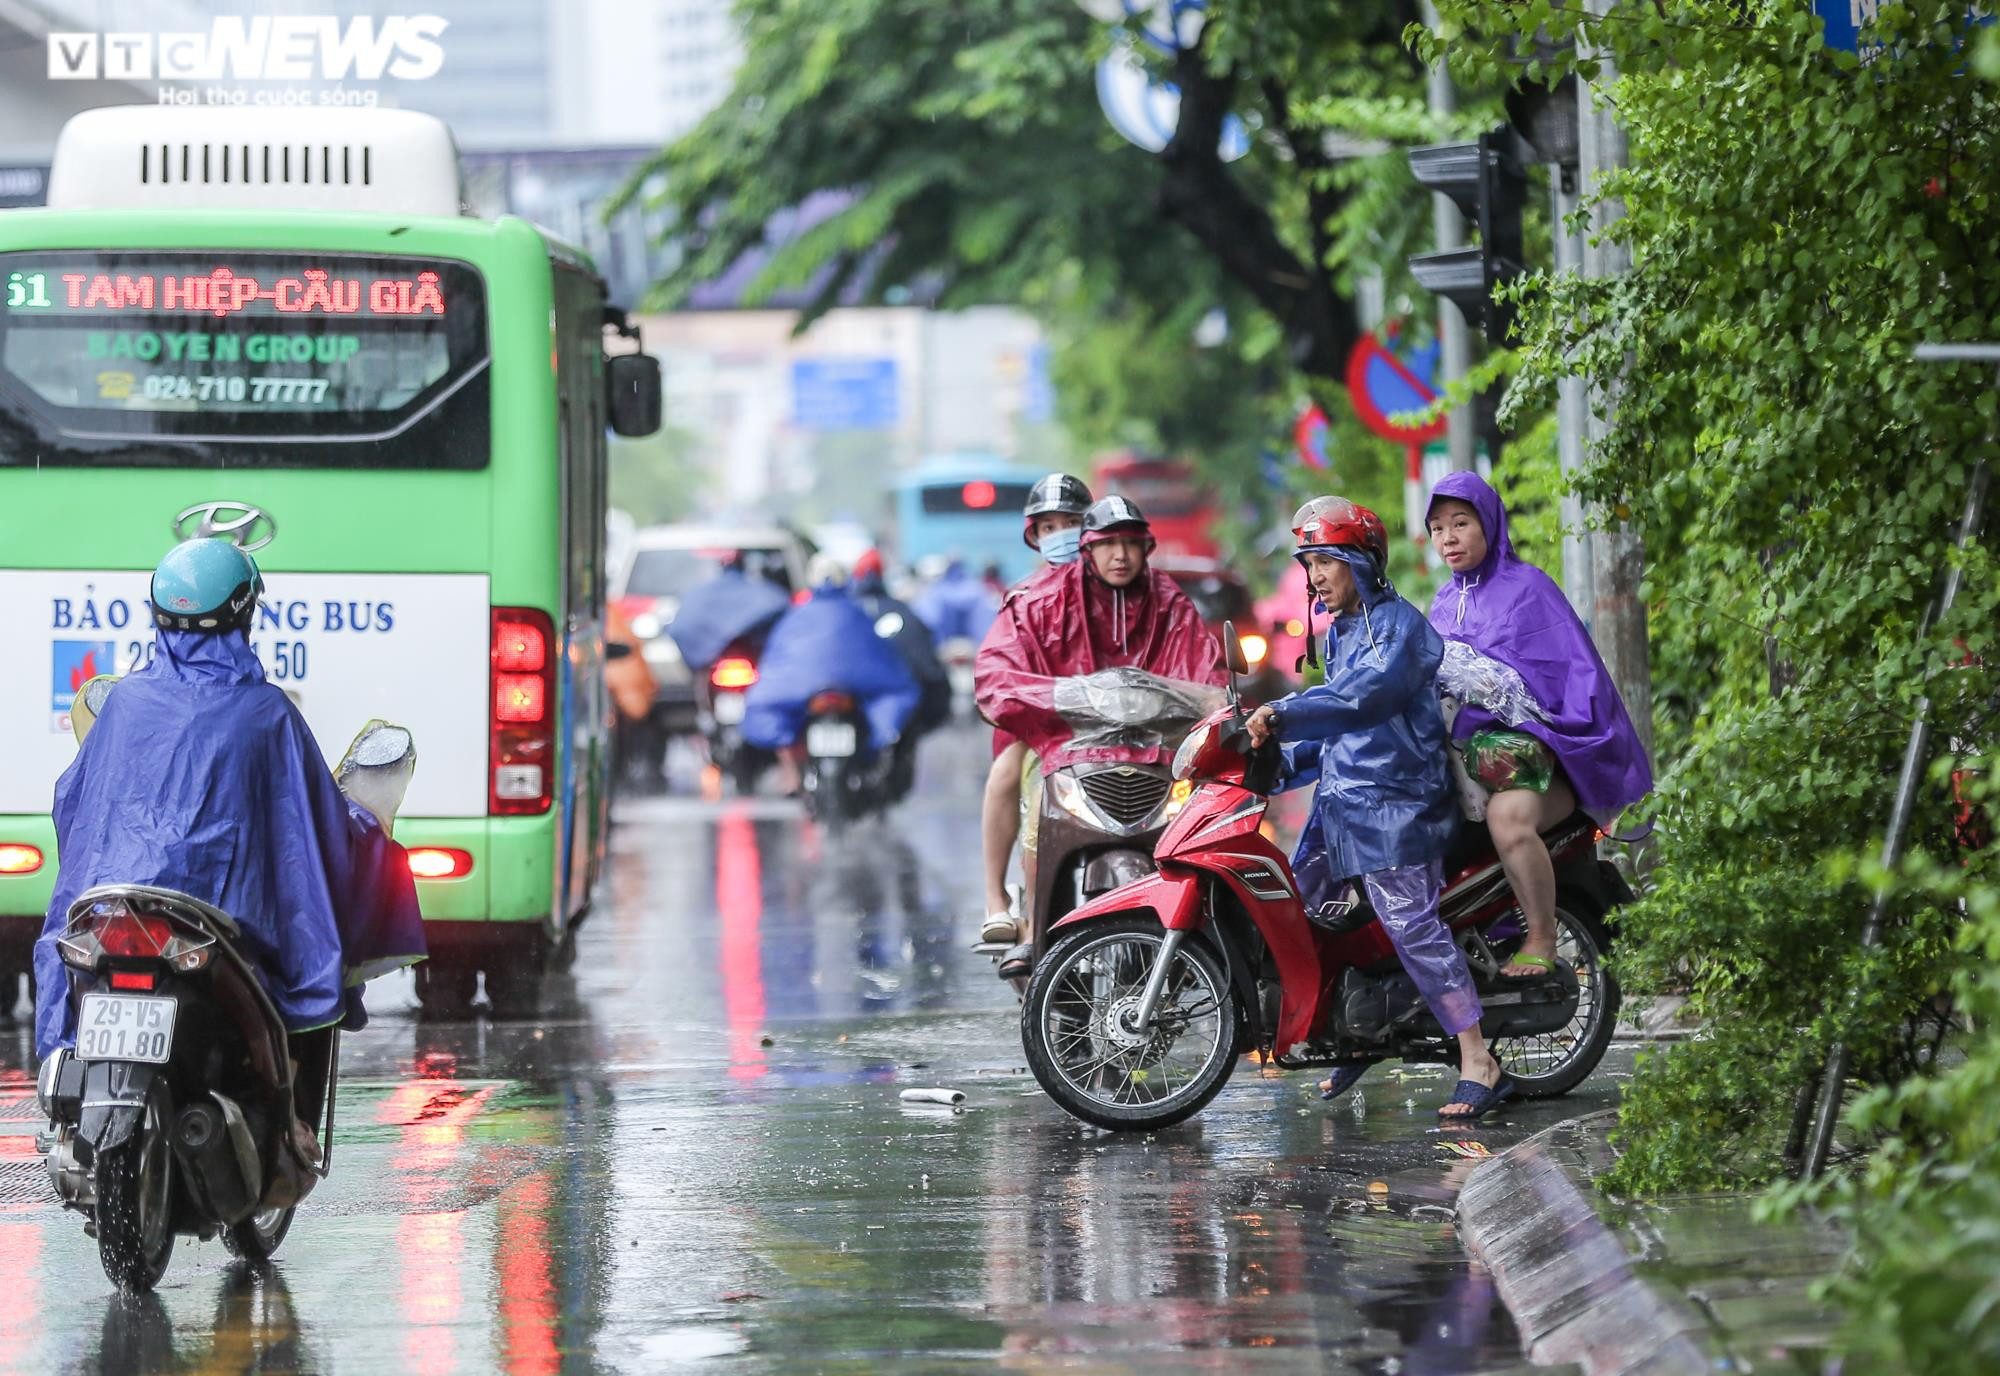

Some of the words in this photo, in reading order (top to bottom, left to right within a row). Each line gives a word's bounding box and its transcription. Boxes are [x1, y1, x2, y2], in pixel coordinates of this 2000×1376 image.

[62, 274, 153, 308] TAM
[245, 335, 360, 363] GROUP
[143, 375, 193, 400] 024
[196, 376, 246, 401] 710
[249, 378, 330, 403] 77777
[51, 583, 130, 629] BẢO
[323, 602, 394, 631] BUS
[1243, 871, 1271, 879] HONDA
[94, 1000, 162, 1028] 29-V5
[82, 1028, 167, 1058] 301.80
